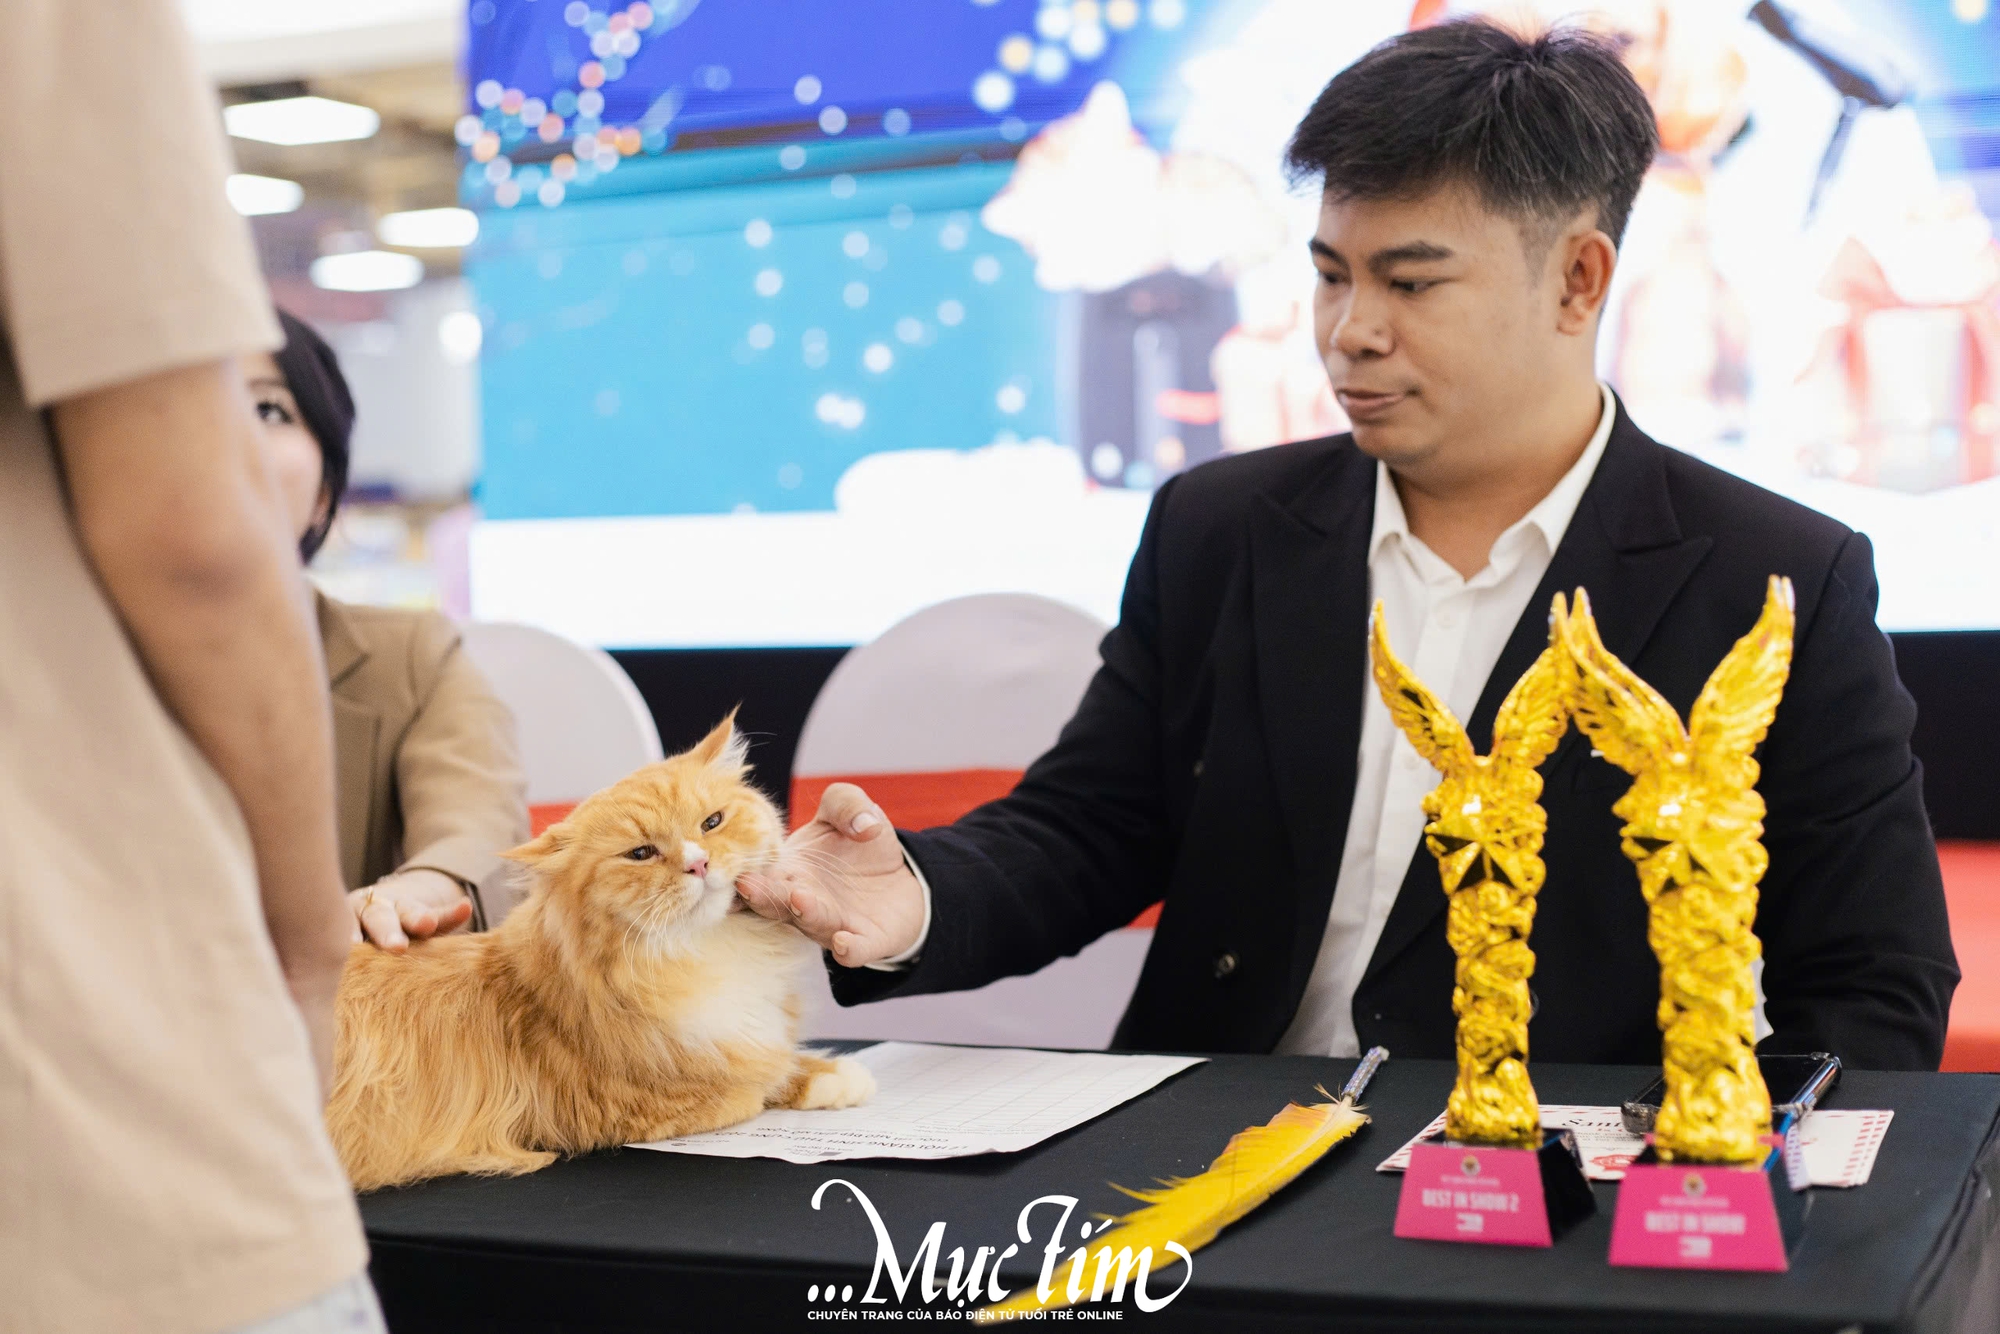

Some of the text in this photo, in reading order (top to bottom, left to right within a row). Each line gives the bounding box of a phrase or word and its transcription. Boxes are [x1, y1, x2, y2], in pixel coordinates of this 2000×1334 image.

[1422, 1189, 1520, 1213] BEST IN SHOW 2
